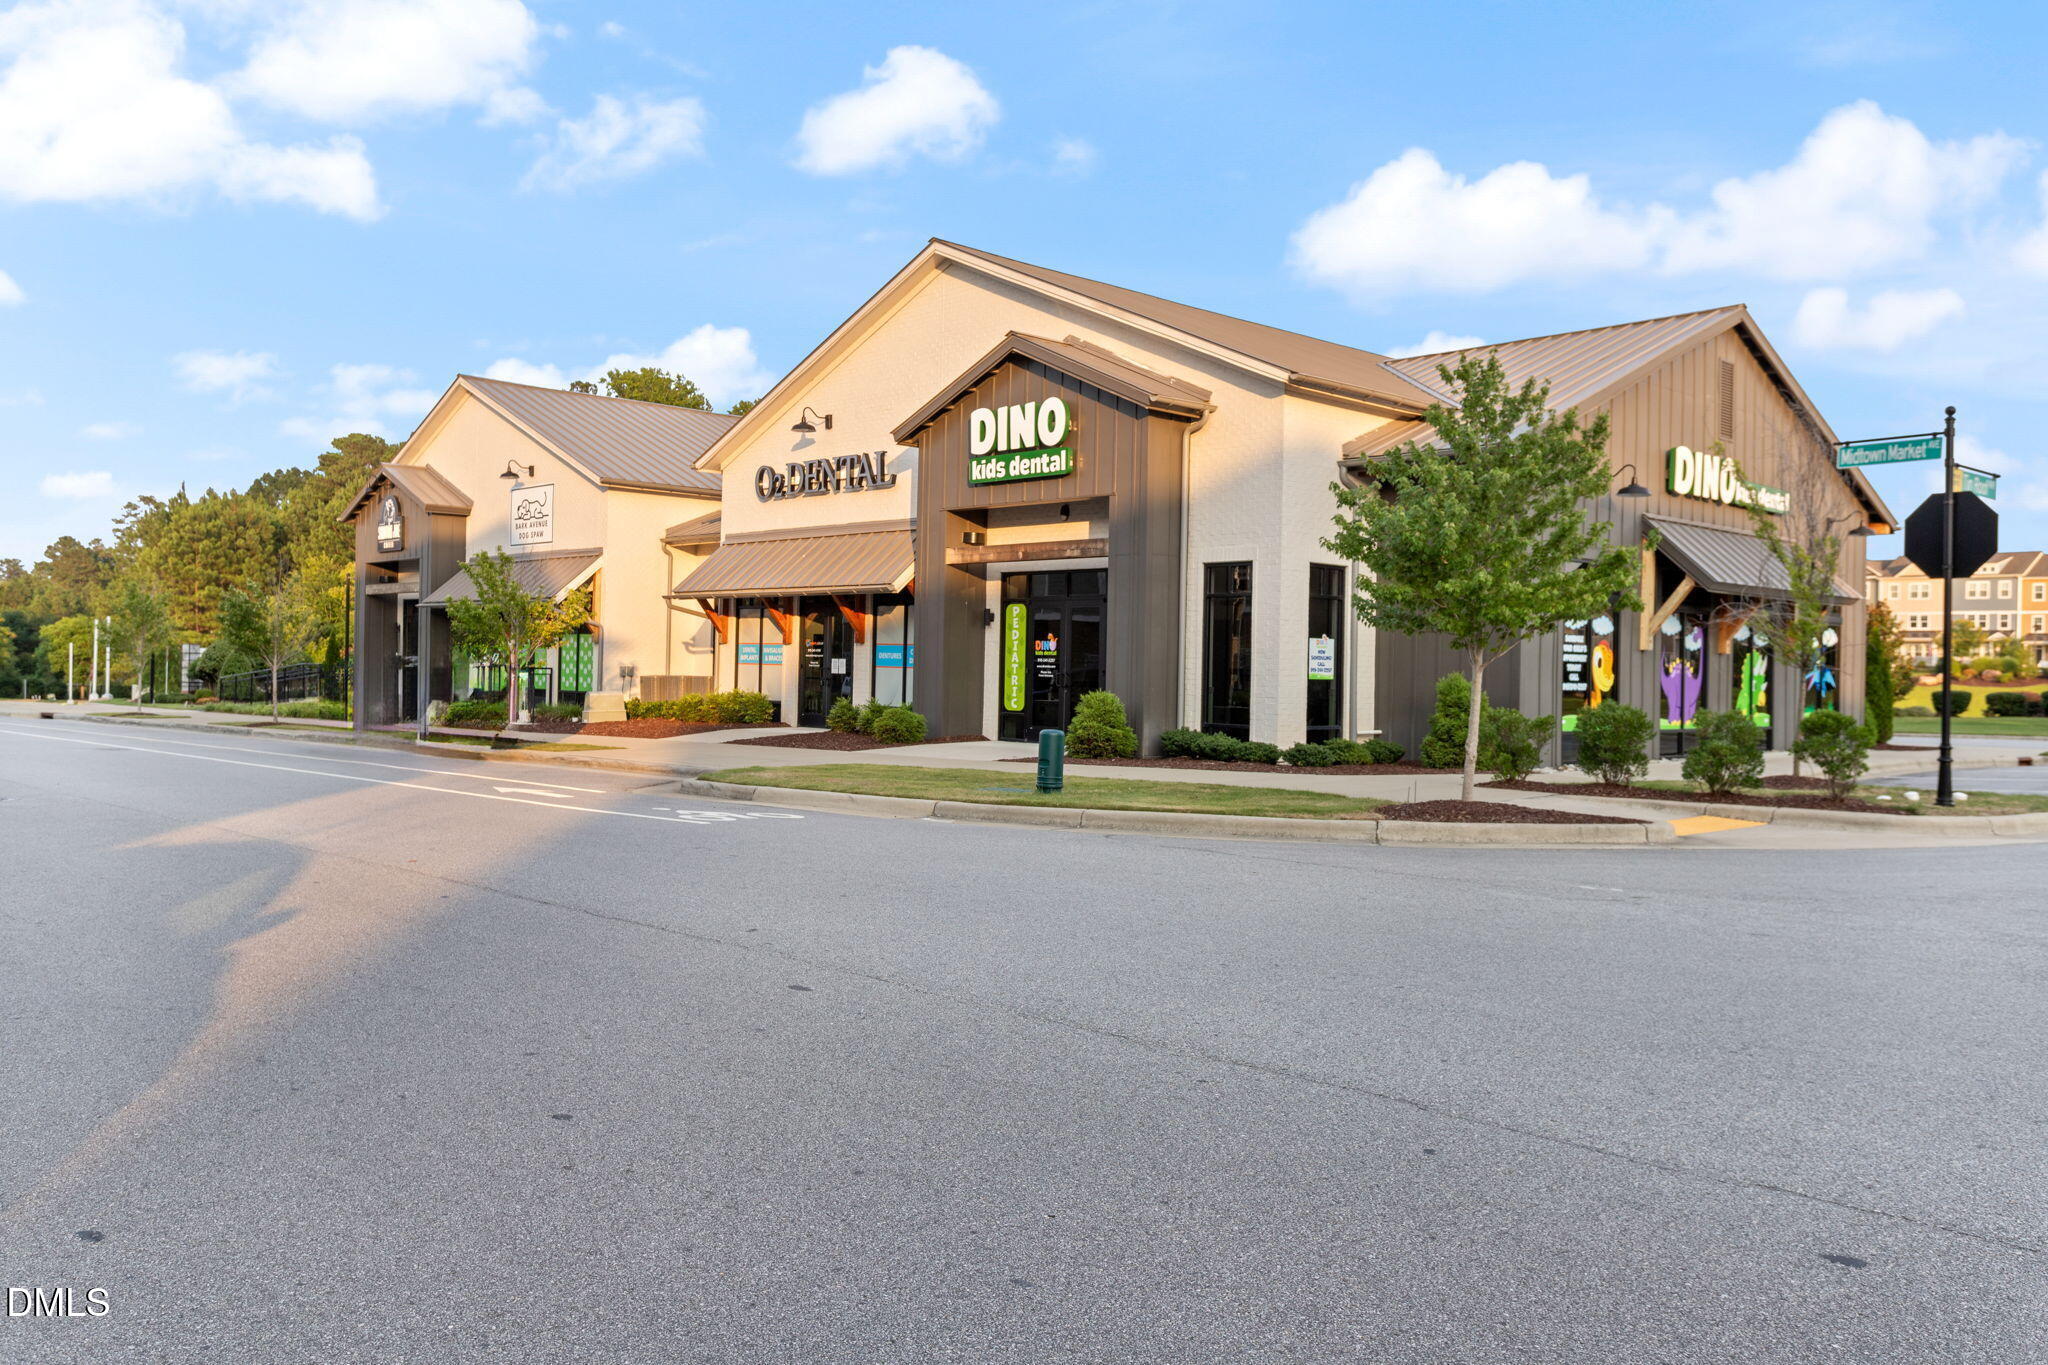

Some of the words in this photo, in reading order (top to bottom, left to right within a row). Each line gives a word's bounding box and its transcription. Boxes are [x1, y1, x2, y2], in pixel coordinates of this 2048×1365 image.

[970, 397, 1066, 455] DINO
[971, 458, 1006, 480] kids
[1009, 450, 1066, 476] dental
[1674, 445, 1737, 504] DINO
[1841, 448, 1887, 465] Midtown
[1888, 442, 1926, 460] Market
[1010, 606, 1021, 709] PEDIATRIC
[1035, 639, 1057, 651] DINO
